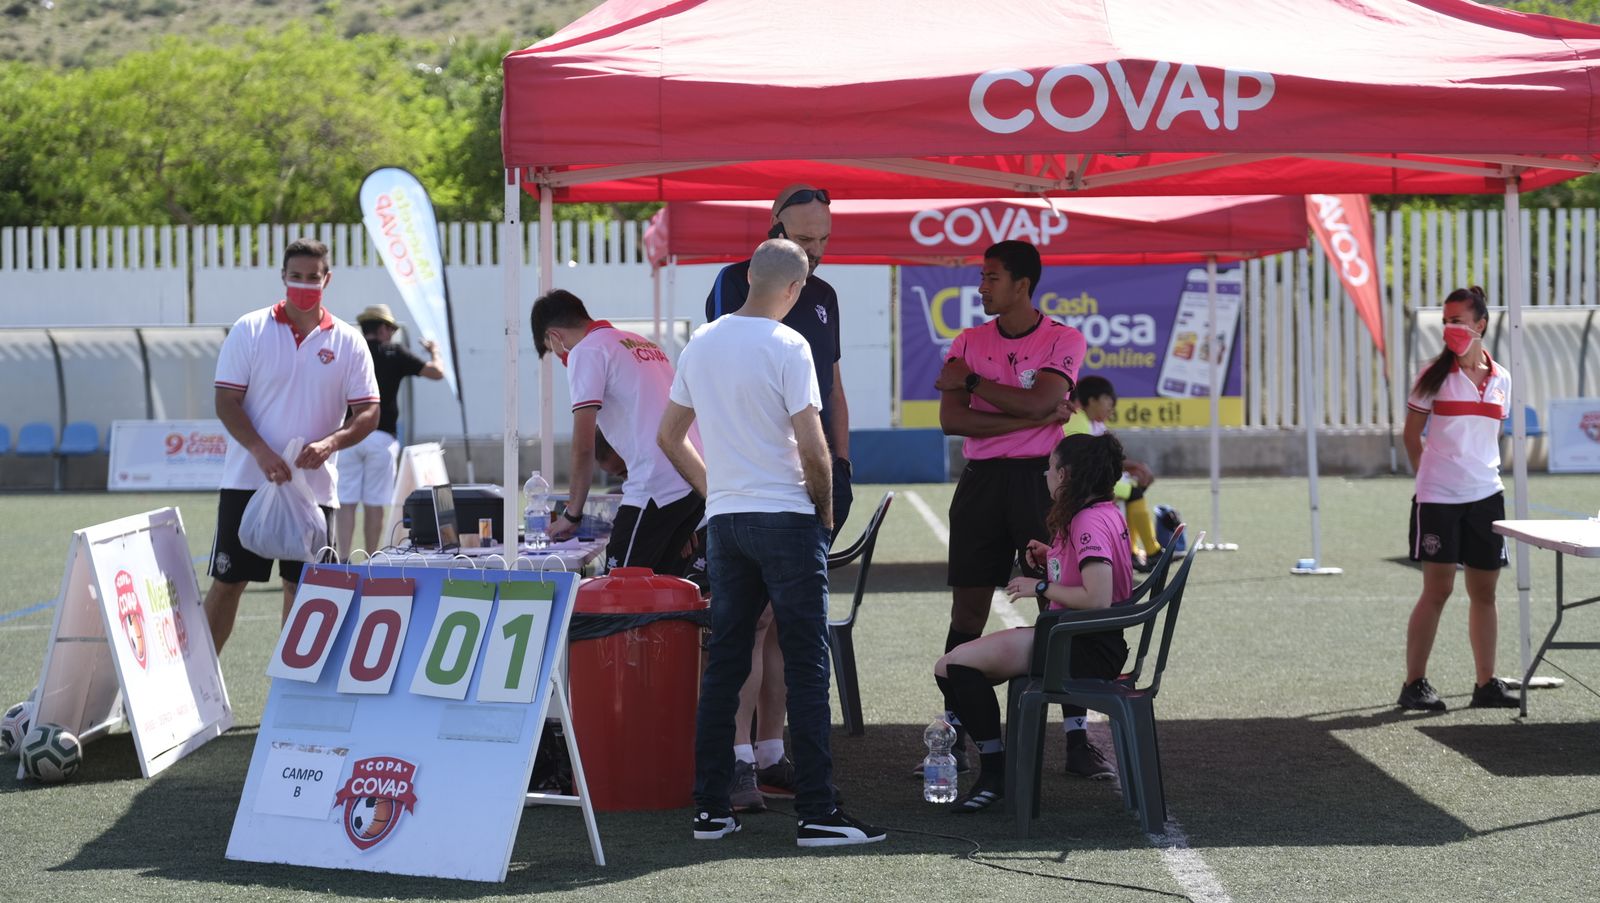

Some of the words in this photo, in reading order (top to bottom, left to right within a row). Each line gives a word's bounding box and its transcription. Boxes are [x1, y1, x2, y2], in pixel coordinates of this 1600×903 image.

[968, 59, 1276, 134] COVAP
[909, 207, 1068, 246] COVAP
[1040, 291, 1098, 316] Cash
[1049, 313, 1157, 346] rosa
[1085, 346, 1157, 369] Online
[1125, 402, 1151, 423] de
[1158, 401, 1181, 423] ti!
[282, 767, 324, 782] CAMPO
[365, 760, 403, 773] COPA
[293, 785, 302, 798] B
[351, 777, 409, 798] COVAP
